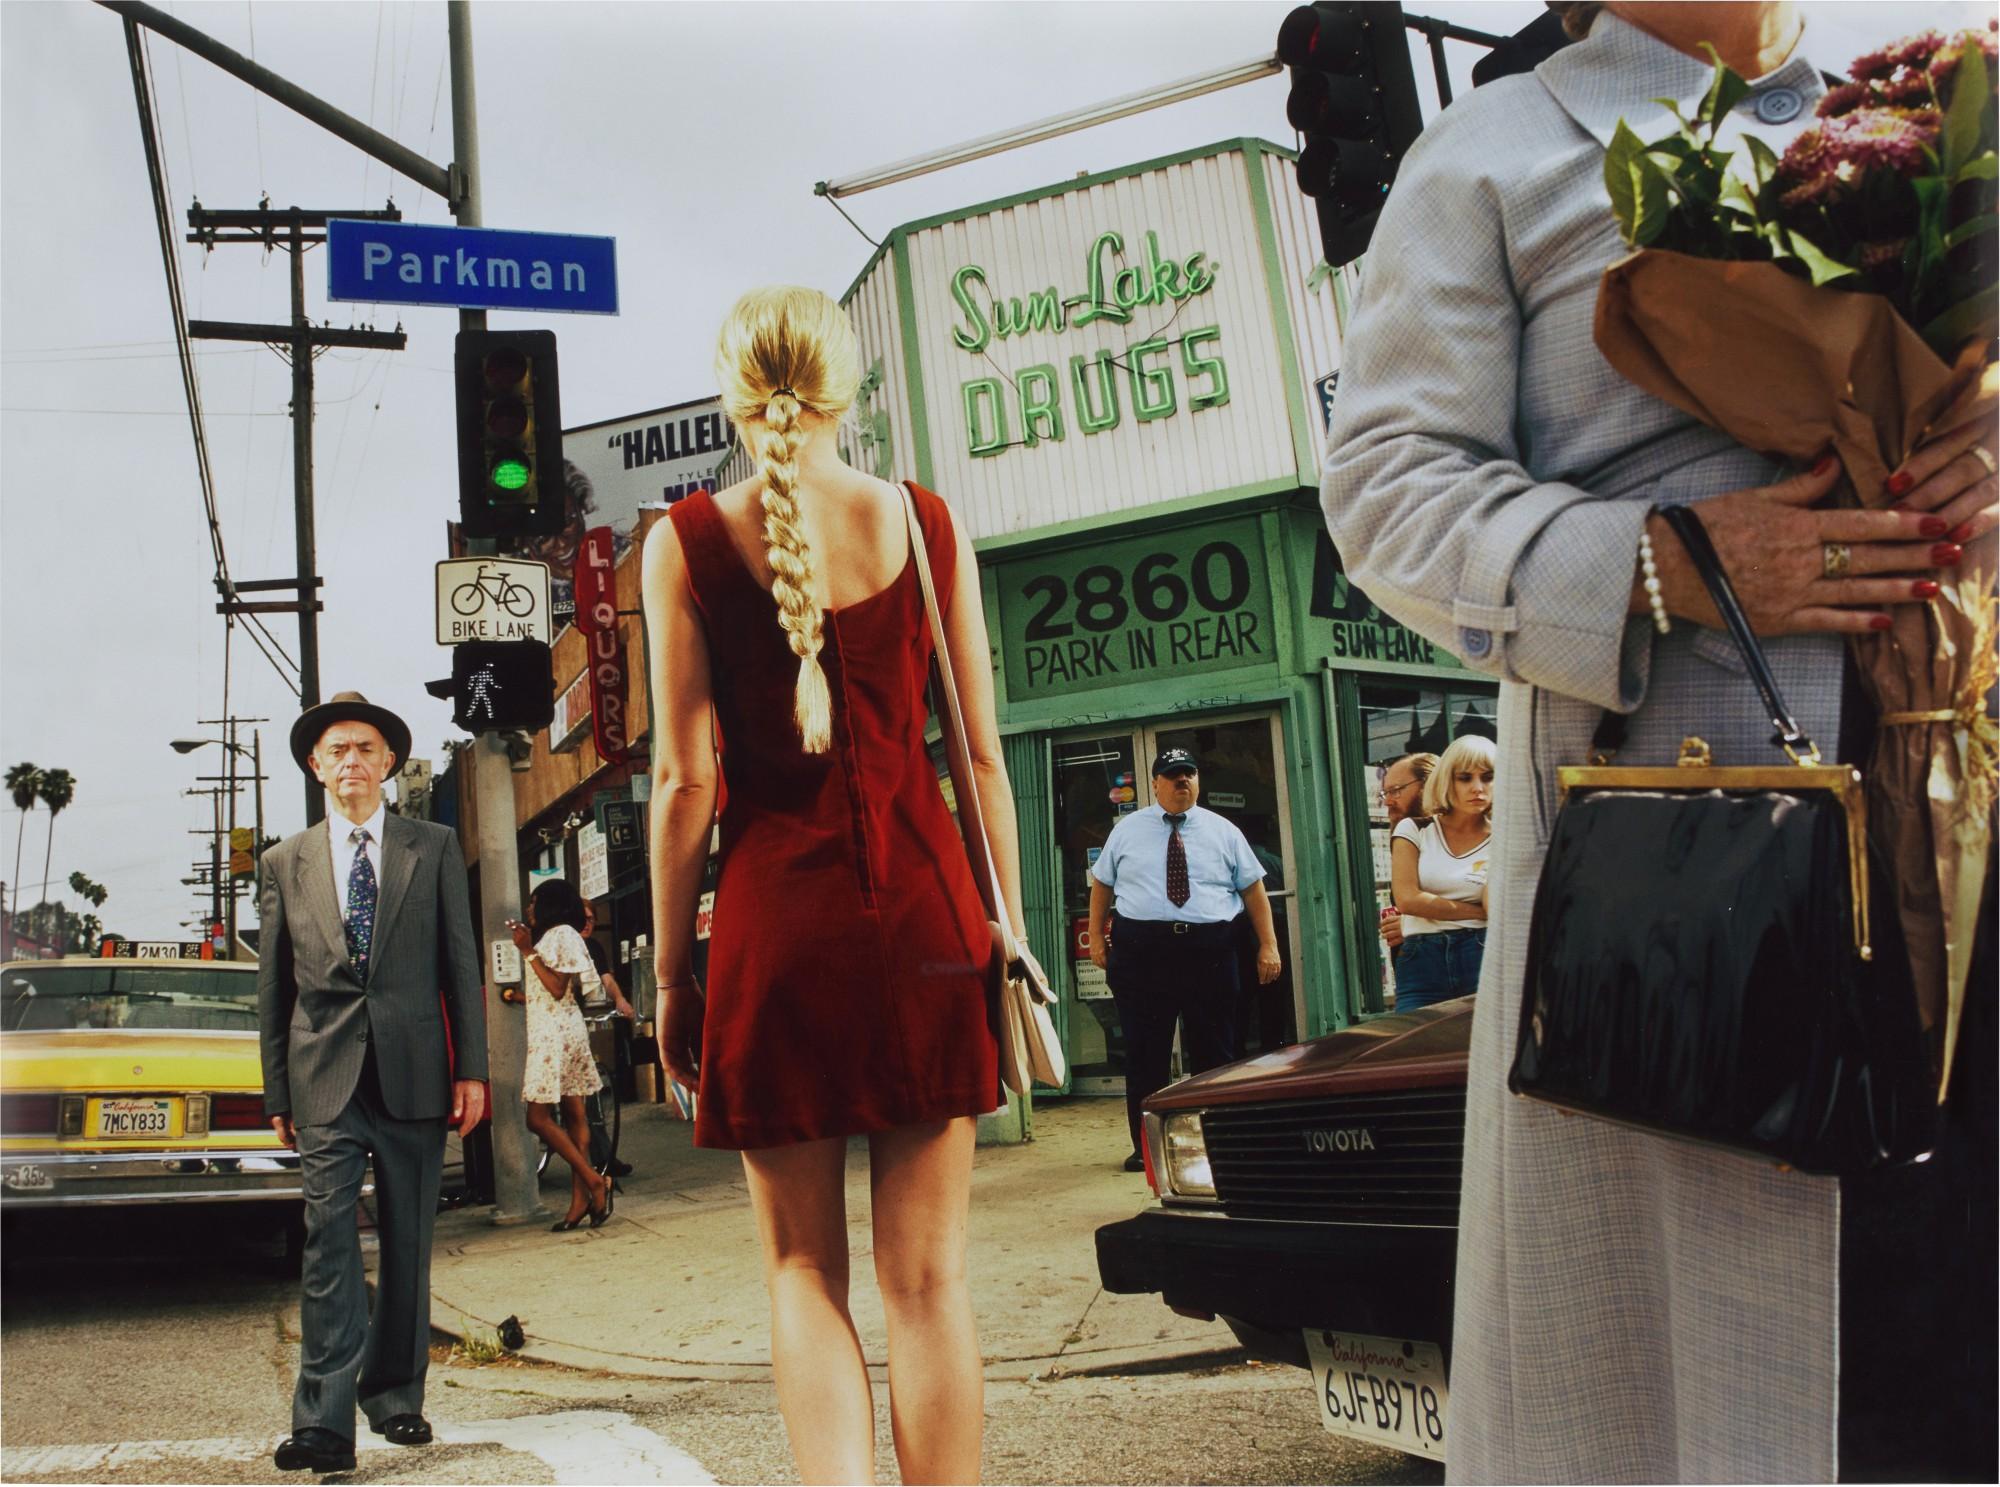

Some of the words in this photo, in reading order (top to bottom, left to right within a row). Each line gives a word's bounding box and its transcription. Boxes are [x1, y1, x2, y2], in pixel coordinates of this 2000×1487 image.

[362, 241, 586, 293] Parkman
[960, 324, 1230, 458] DRUGS
[677, 467, 713, 482] TYLE
[1022, 540, 1250, 642] 2860
[452, 620, 488, 637] BIKE
[496, 621, 535, 638] LANE
[1333, 622, 1377, 660] SUN
[1384, 625, 1435, 665] LAKE
[588, 539, 624, 751] LIQUORS
[1025, 633, 1119, 688] PARK
[1127, 627, 1157, 670] IN
[1168, 611, 1261, 665] REAR
[697, 911, 712, 934] OPE
[117, 943, 131, 952] OFF
[140, 946, 177, 959] 2M30
[186, 943, 199, 953] OFF
[103, 1113, 166, 1131] 7MCY833
[1303, 1129, 1376, 1152] TOYOTA
[1332, 1337, 1416, 1373] California
[1325, 1367, 1443, 1441] 6JFB978
